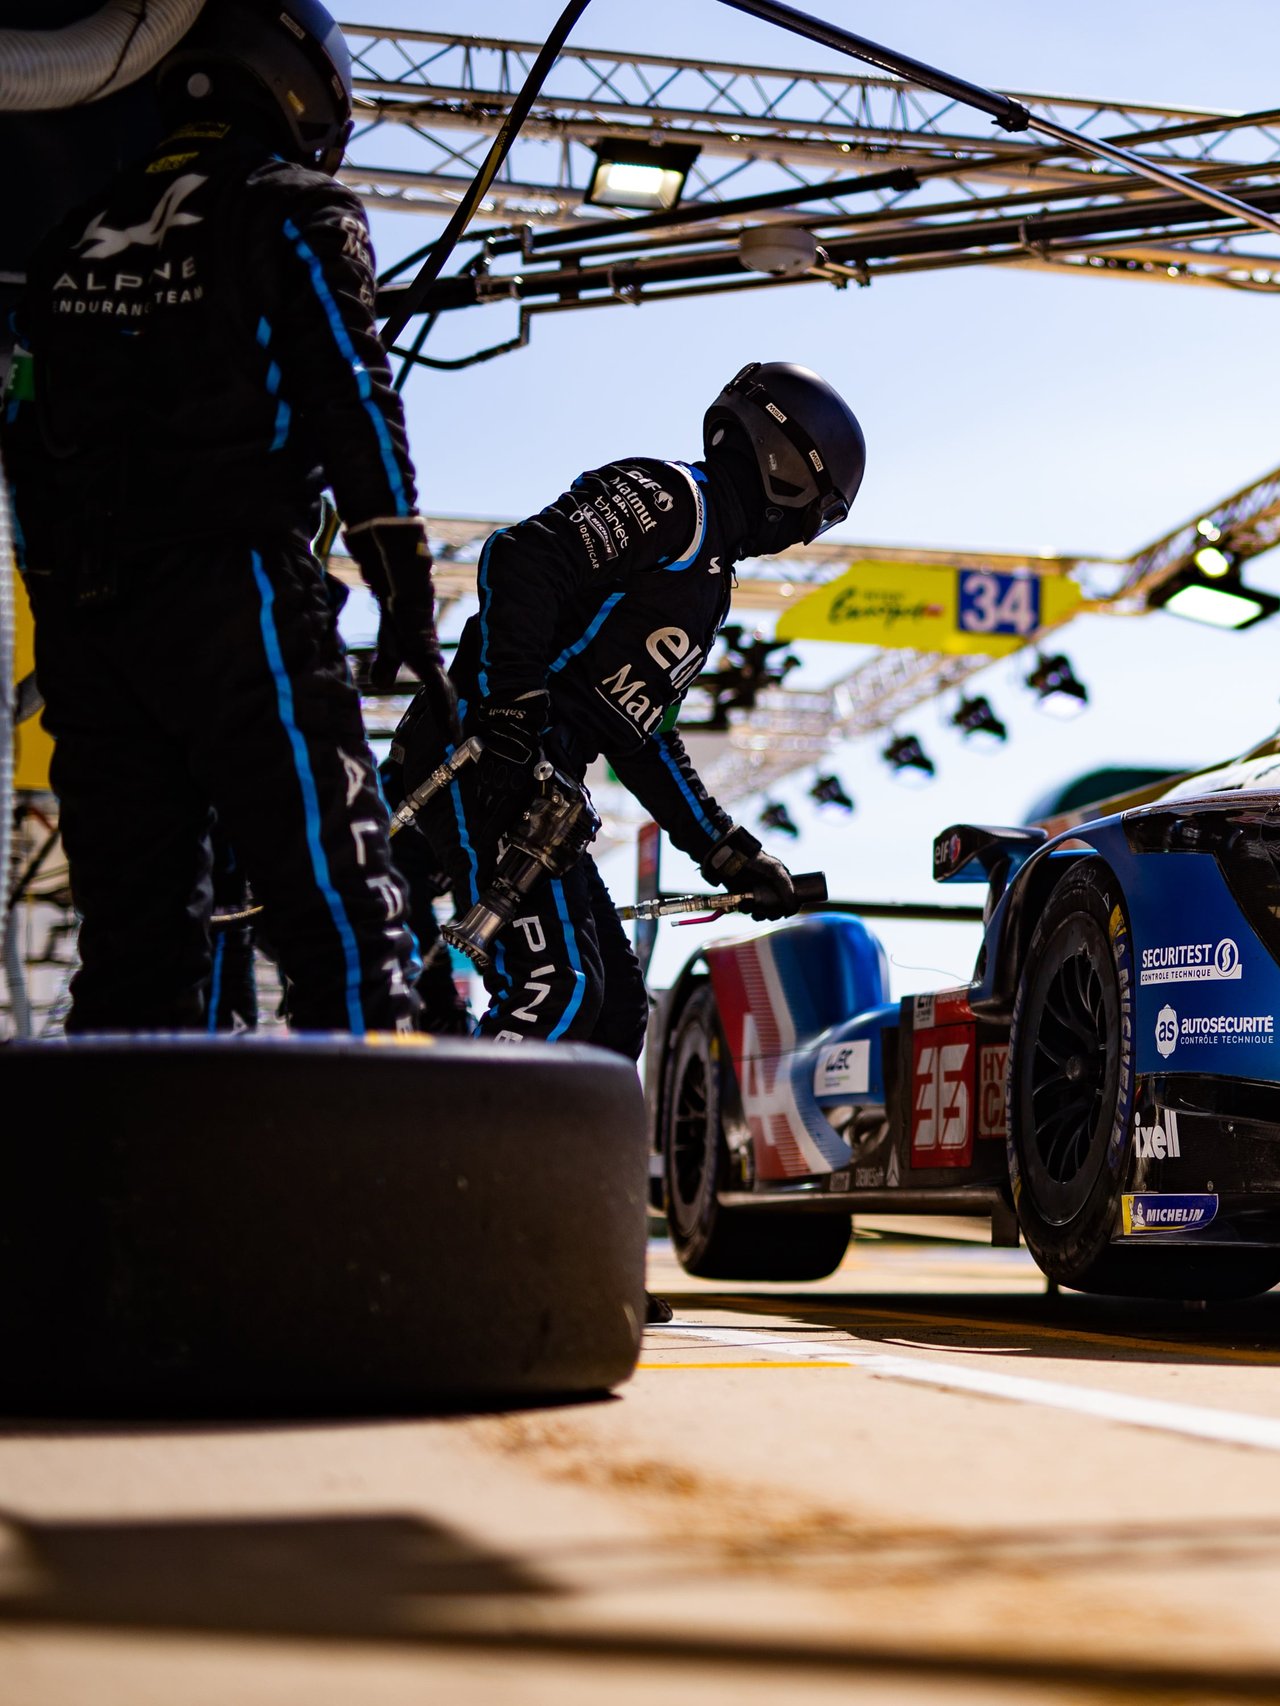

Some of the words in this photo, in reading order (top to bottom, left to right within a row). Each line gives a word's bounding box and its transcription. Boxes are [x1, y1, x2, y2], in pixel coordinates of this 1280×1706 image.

[53, 256, 197, 290] ALPNE
[53, 299, 151, 317] NDURAN
[767, 404, 787, 423] MSA
[809, 450, 824, 472] MSA
[610, 476, 657, 532] Matmut
[594, 496, 629, 549] thiriet
[963, 574, 1035, 632] 34
[935, 840, 950, 865] elf
[1142, 944, 1213, 969] SECURITEST
[1141, 971, 1169, 982] CONTROLE
[1171, 968, 1211, 979] TECHNIQUE
[1181, 1034, 1218, 1045] CONTRÔLE
[1222, 1035, 1274, 1045] TECHNIQUE
[914, 1043, 970, 1151] 36
[1135, 1109, 1181, 1160] ixell
[1146, 1208, 1205, 1222] MICHELIN
